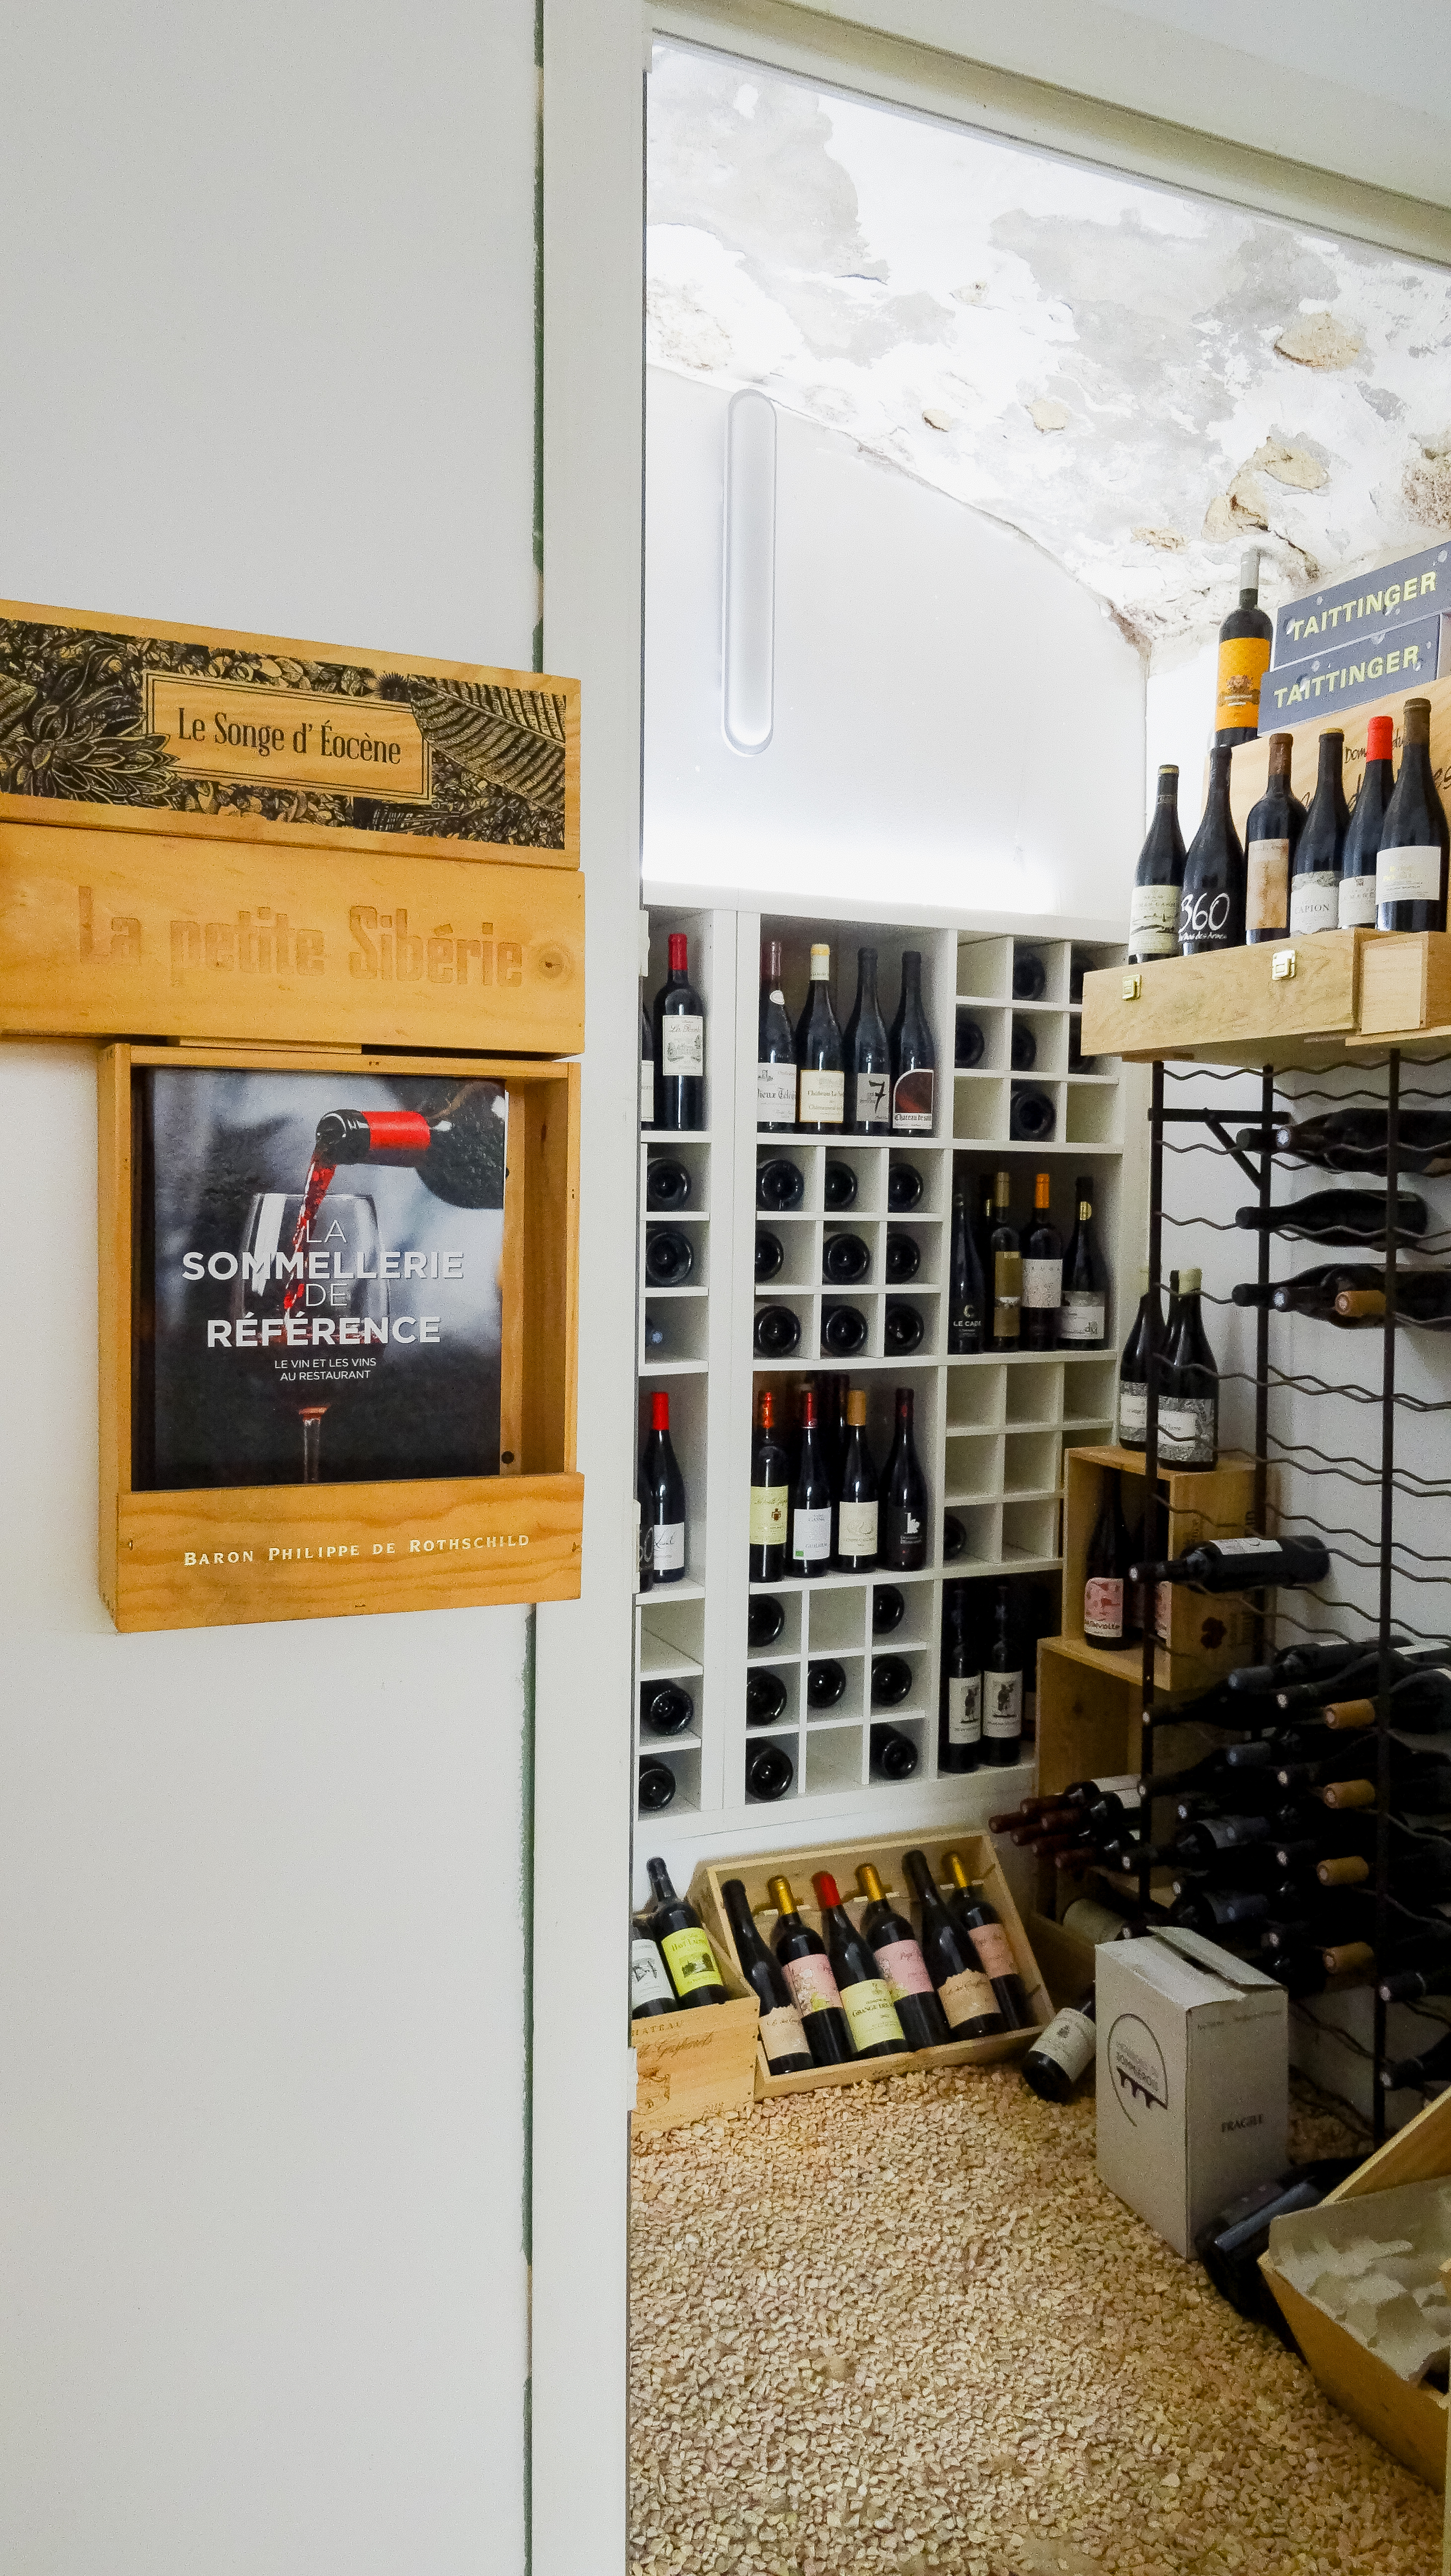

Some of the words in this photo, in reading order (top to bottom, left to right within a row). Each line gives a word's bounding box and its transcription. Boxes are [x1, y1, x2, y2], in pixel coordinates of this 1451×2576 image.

[1292, 570, 1437, 642] TAITTINGER
[1273, 644, 1420, 709] TAITTINGER
[178, 707, 206, 741] Le
[214, 712, 285, 757] Songe
[1178, 892, 1230, 934] 360
[78, 886, 143, 967] La
[169, 906, 326, 988] petite
[349, 905, 524, 988] Sibérie
[869, 1080, 887, 1114] 7
[305, 1219, 347, 1244] LA
[181, 1250, 465, 1282] SOMMELLERIE
[305, 1283, 348, 1307] DE
[207, 1311, 442, 1348] RÉFÉRENCE
[275, 1360, 288, 1368] LE
[291, 1360, 310, 1368] VIN
[313, 1359, 326, 1368] ET
[329, 1358, 349, 1367] LES
[352, 1358, 376, 1367] VINS
[280, 1372, 296, 1381] AU
[299, 1370, 371, 1380] RESTAURANT
[1221, 2114, 1264, 2133] FRAGILE
